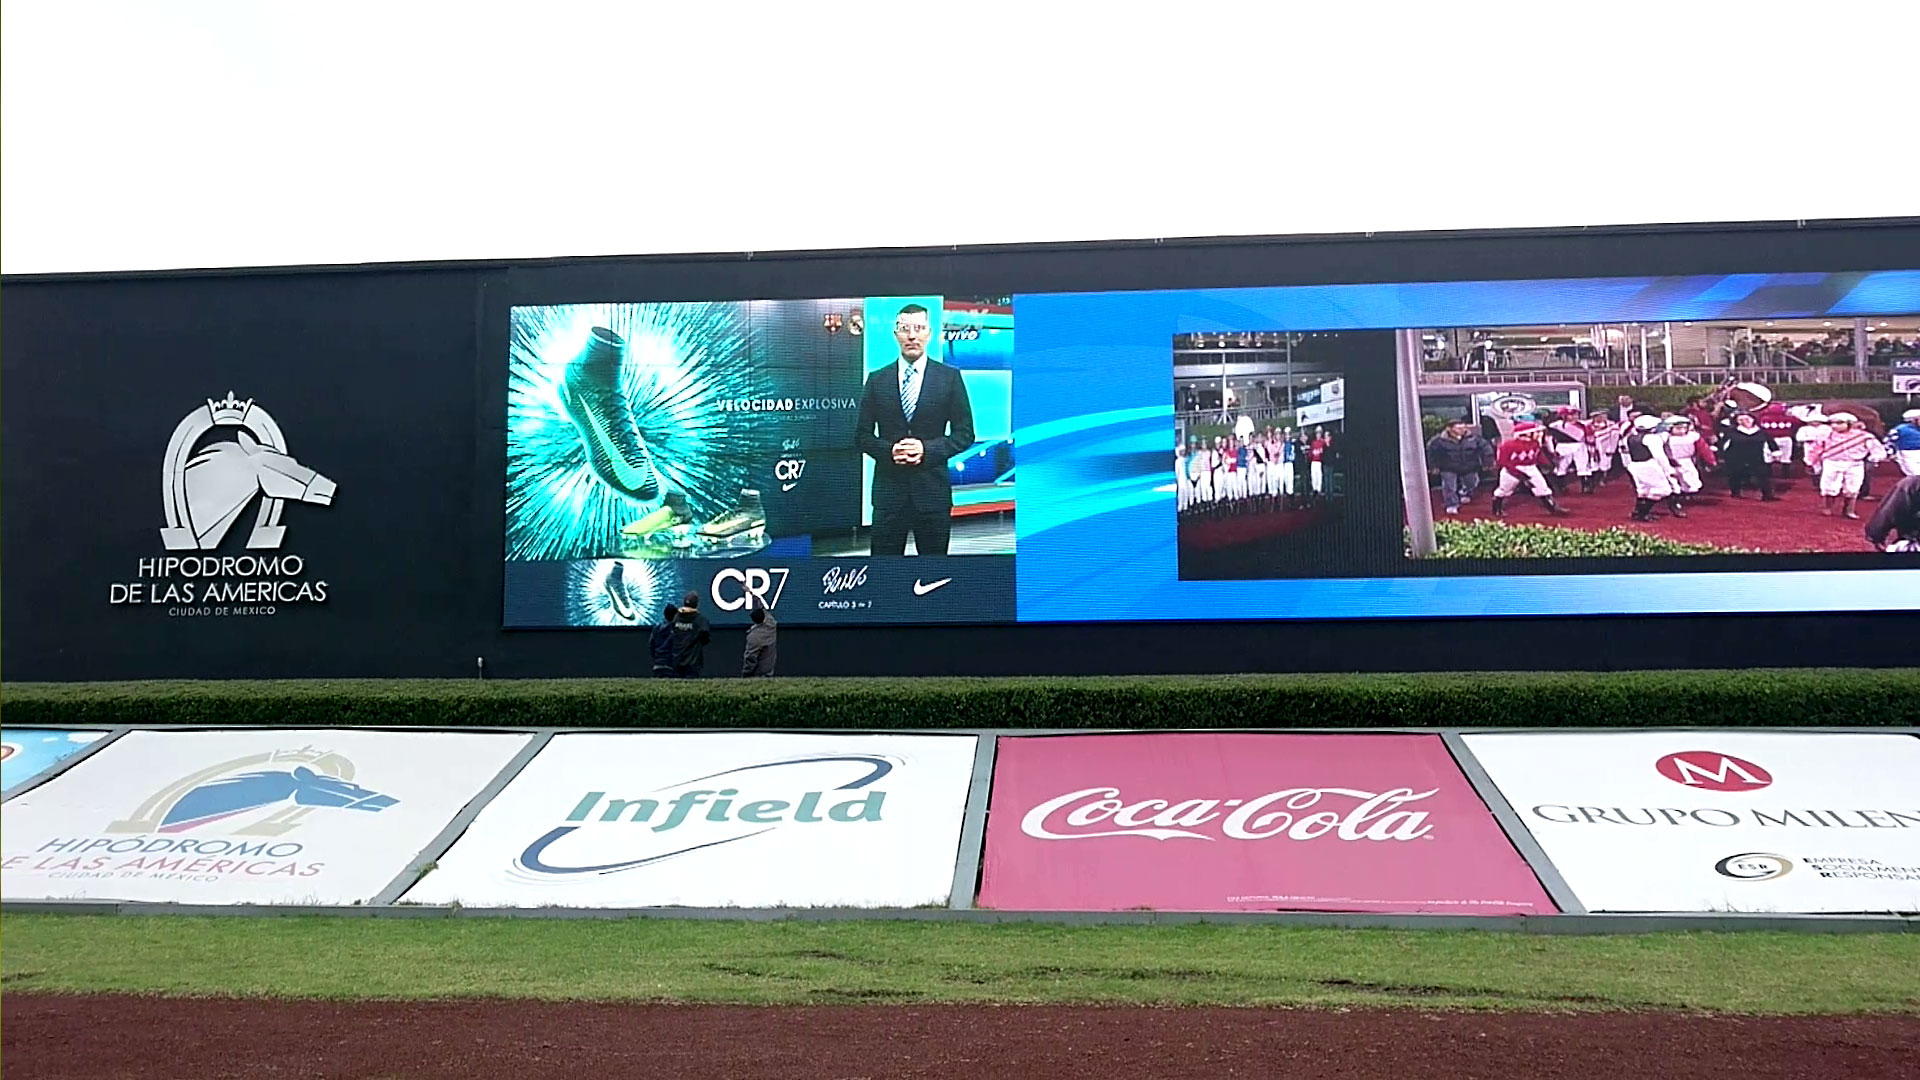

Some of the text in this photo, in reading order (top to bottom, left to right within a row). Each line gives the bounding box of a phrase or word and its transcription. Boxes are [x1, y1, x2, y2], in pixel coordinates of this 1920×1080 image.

[774, 459, 806, 480] CR7
[138, 555, 304, 578] HIPODROMO
[109, 580, 328, 604] DE LAS AMERICAS
[711, 567, 790, 611] CR7
[168, 606, 277, 617] CIUDAD DE MEXICO
[1673, 756, 1770, 785] M
[564, 788, 886, 833] Infield
[1021, 787, 1440, 841] Coca-Cola
[1531, 804, 1741, 827] GRUPO
[36, 835, 304, 858] HIPÓDROMO
[1, 854, 325, 877] E LAS AMÉRICAS
[1802, 857, 1882, 866] EMPRESA
[48, 872, 115, 880] CIUDAD
